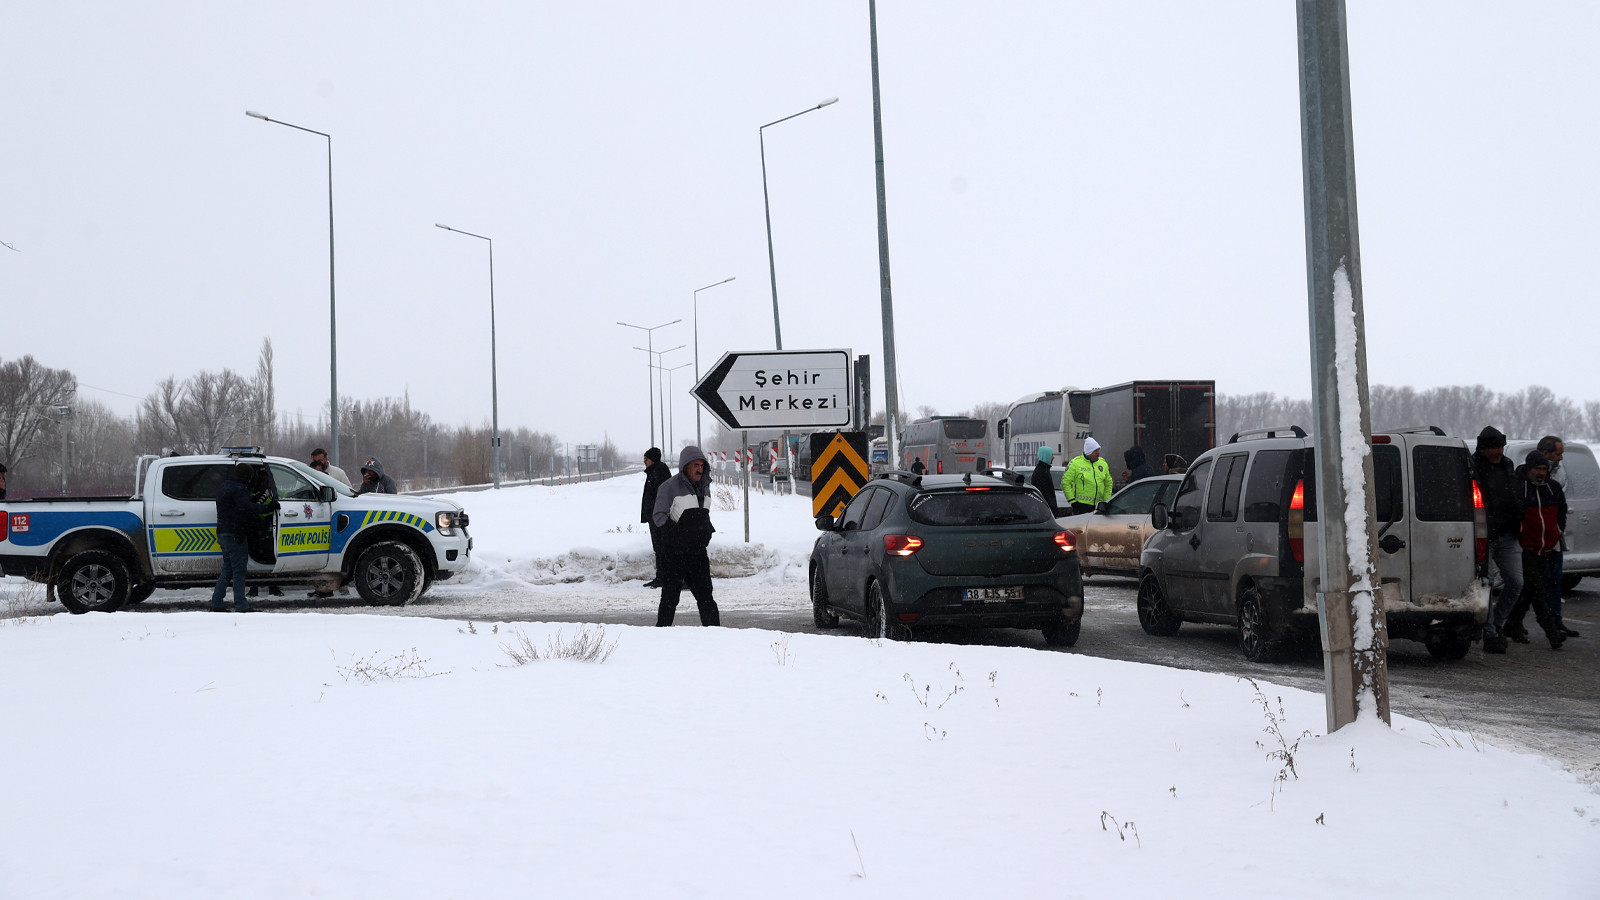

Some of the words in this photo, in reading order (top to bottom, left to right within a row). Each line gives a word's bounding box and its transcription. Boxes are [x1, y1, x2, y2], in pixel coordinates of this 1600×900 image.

[755, 370, 820, 388] Şehir
[739, 394, 837, 411] Merkezi
[13, 516, 27, 525] 112
[281, 530, 306, 546] TRAFİK
[967, 589, 979, 599] 38
